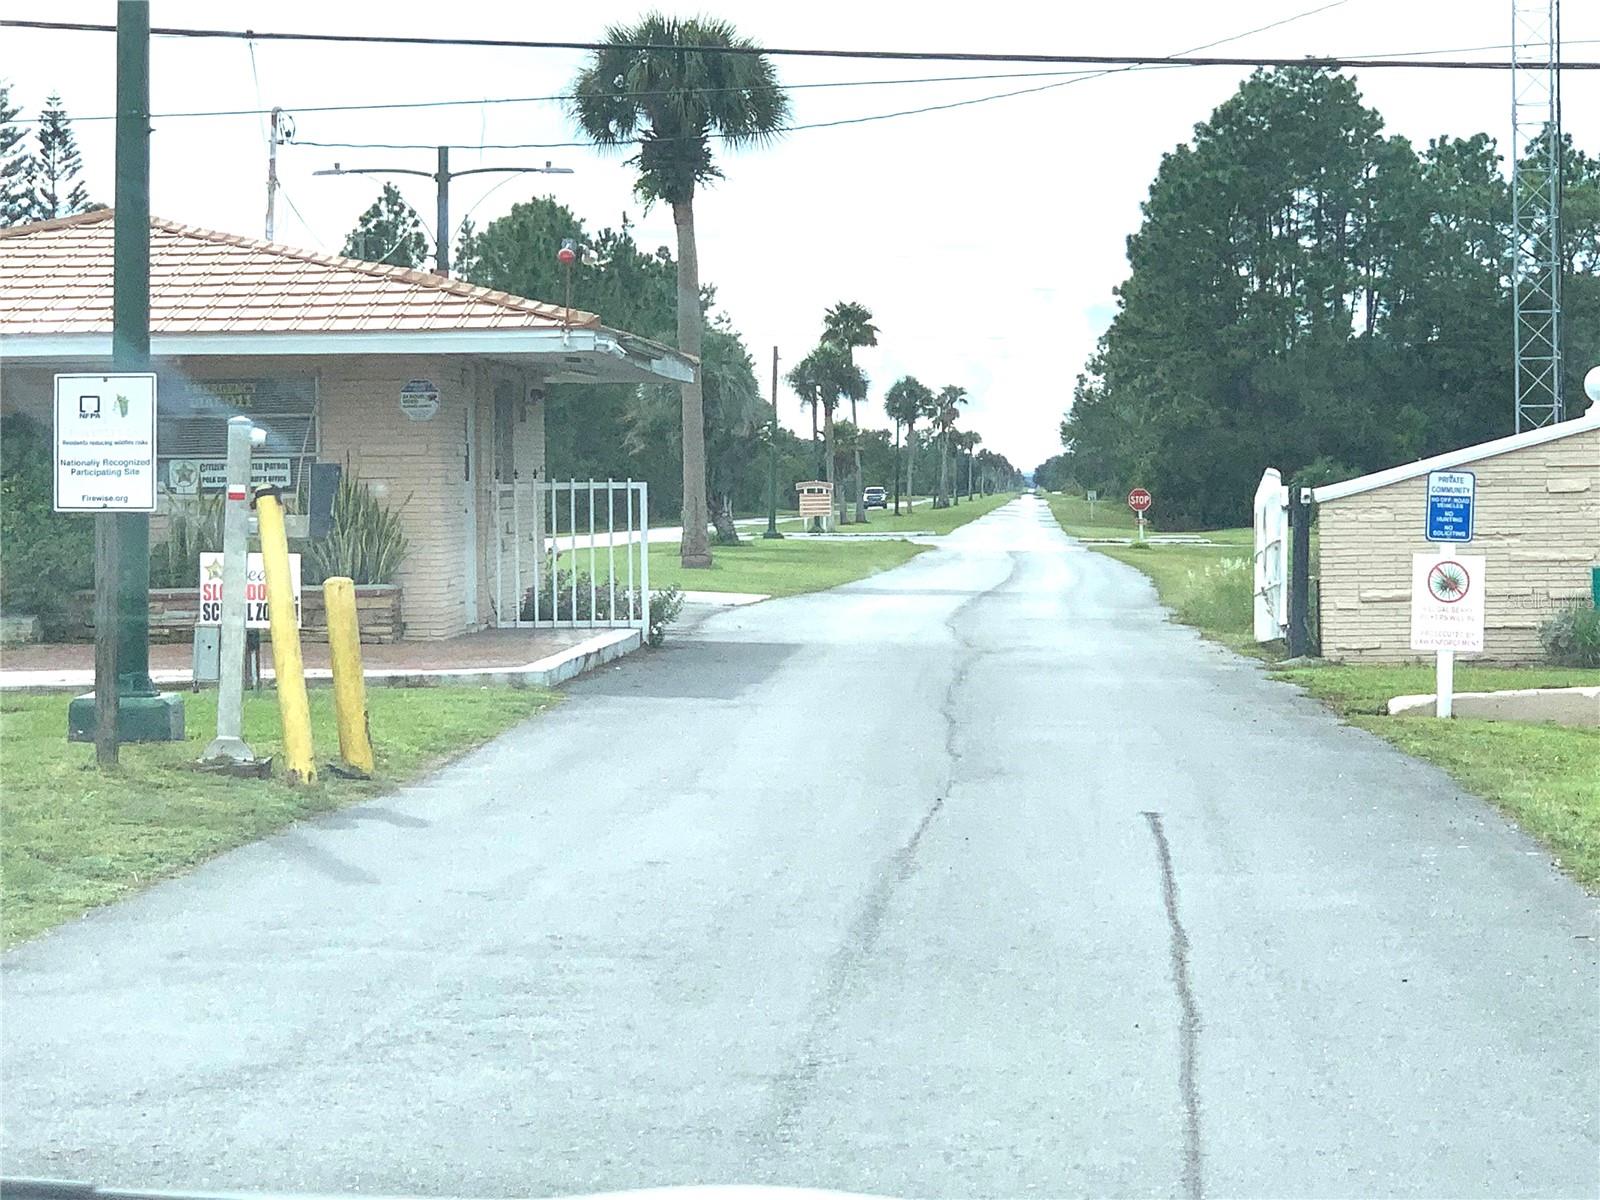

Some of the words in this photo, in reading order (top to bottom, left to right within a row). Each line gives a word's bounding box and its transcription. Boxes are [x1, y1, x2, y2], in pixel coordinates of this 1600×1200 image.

[60, 459, 100, 468] Nationally
[102, 458, 150, 468] Recognized
[71, 468, 122, 477] Participating
[124, 468, 140, 476] Site
[1438, 476, 1465, 484] PRIVATE
[1431, 485, 1471, 494] COMMUNITY
[81, 494, 129, 503] Firewise.org
[1130, 495, 1151, 505] STOP
